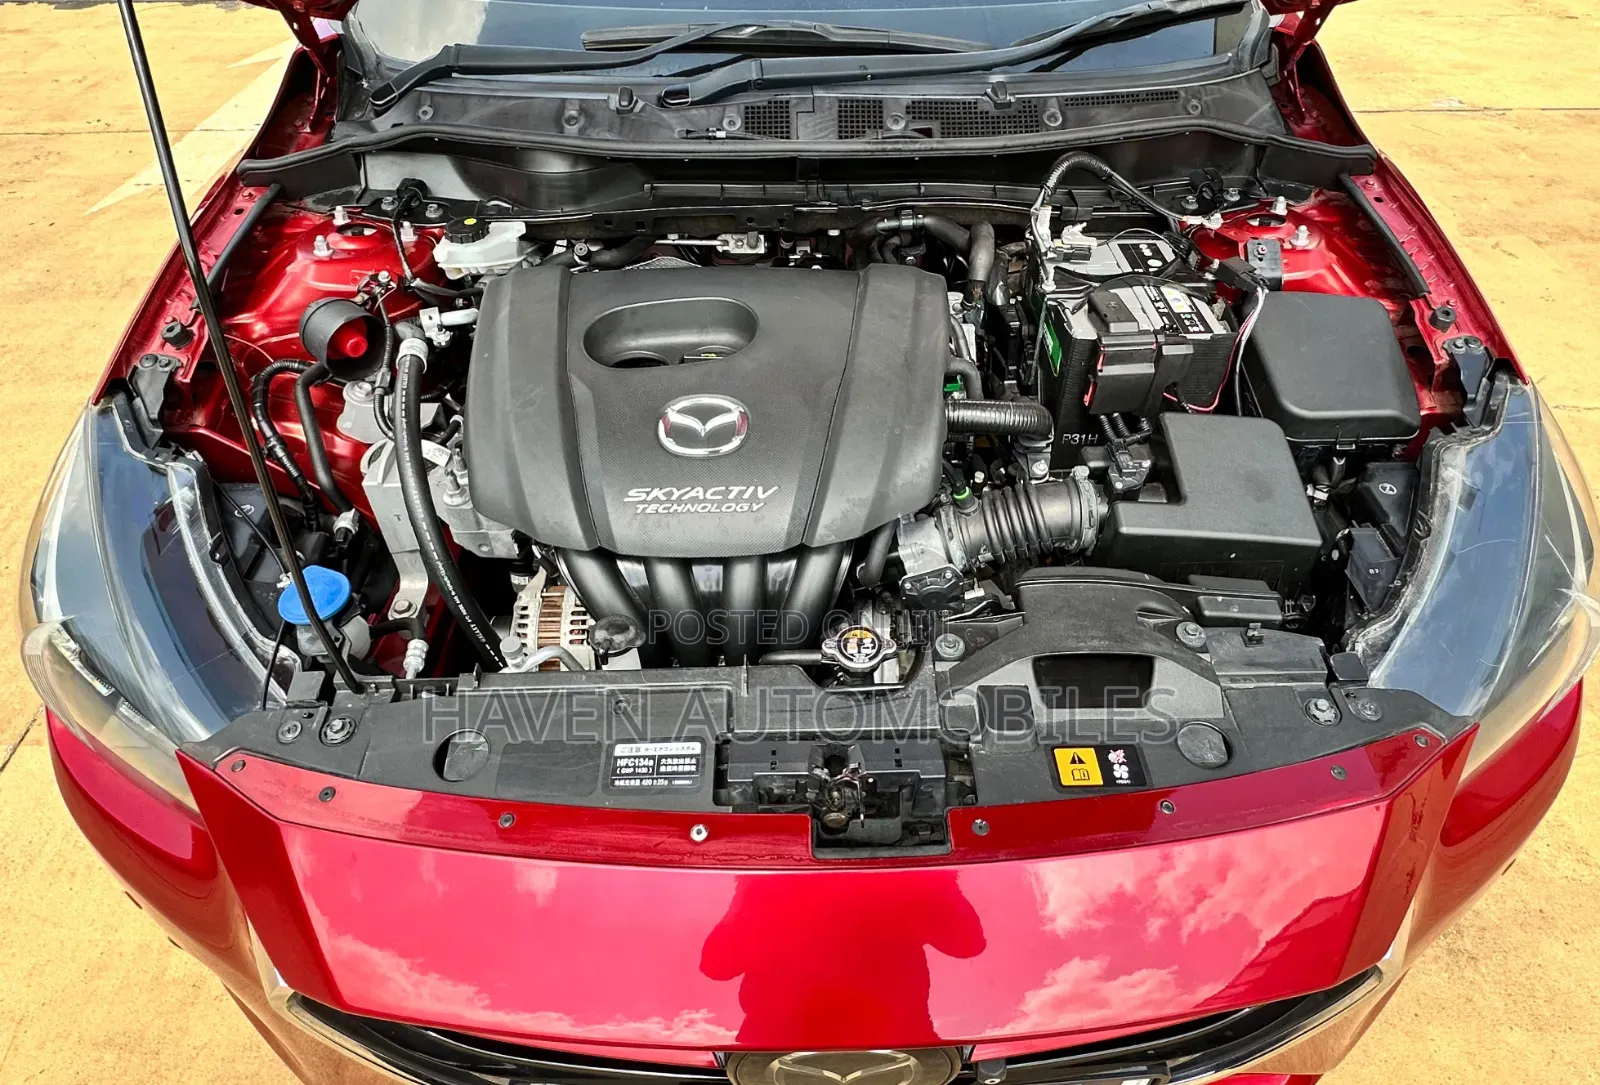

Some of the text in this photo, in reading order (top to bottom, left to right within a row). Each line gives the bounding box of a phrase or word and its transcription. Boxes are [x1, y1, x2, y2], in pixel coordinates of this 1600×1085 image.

[1062, 433, 1098, 445] P31H
[623, 486, 779, 502] SKYACTIV
[636, 502, 766, 514] TECHNOLOGY
[617, 757, 654, 767] HFC134a
